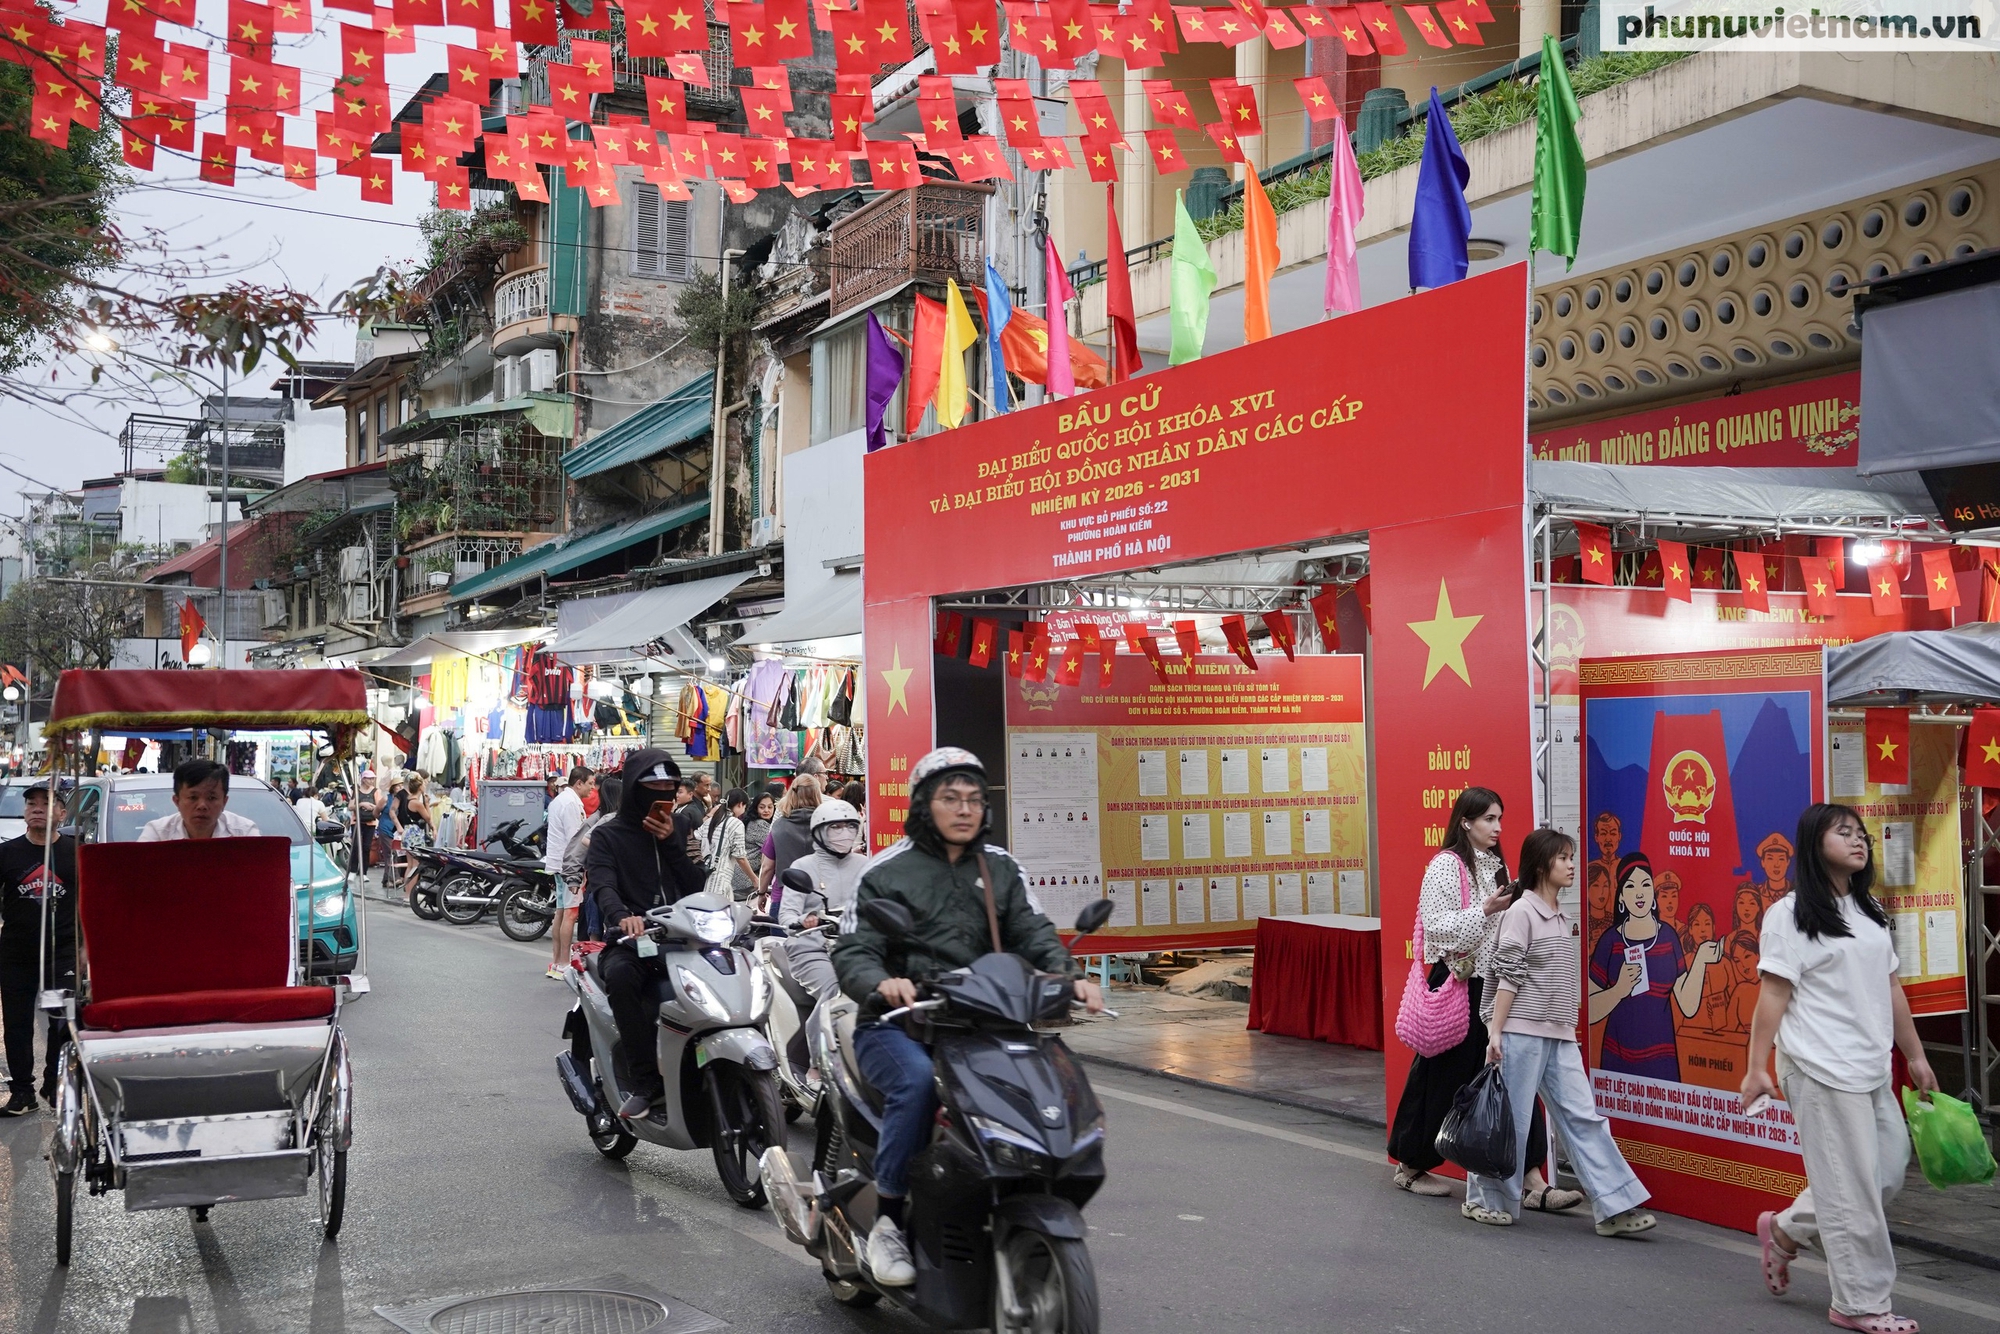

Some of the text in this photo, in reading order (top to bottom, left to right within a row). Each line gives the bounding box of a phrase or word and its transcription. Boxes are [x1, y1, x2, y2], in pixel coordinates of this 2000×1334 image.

[1059, 383, 1162, 434] BẦU CỬ
[978, 390, 1275, 479] ĐẠI BIỂU QUỐC HỘI KHÓA XVI
[1601, 398, 1840, 465] MỪNG ĐẢNG QUANG VINH
[930, 394, 1364, 514] VÀ ĐẠI BIỂU HỘI ĐỒNG NHÂN DÂN CÁC CẤP
[1030, 494, 1076, 516] NHIỆM
[1081, 487, 1101, 507] KỲ
[1104, 480, 1144, 502] 2026
[1160, 468, 1200, 490] 2031
[1060, 518, 1076, 530] KHU
[1078, 514, 1094, 529] VỰC
[1096, 510, 1108, 524] BỎ
[1110, 505, 1136, 522] PHIẾU
[1954, 506, 1976, 522] 46
[1067, 518, 1152, 543] PHƯỜNG HOÀN KIẾM
[1052, 534, 1171, 568] THÀNH PHỐ HÀ NỘI
[1703, 603, 1794, 624] BẢNG NIÊM
[1195, 662, 1230, 675] NIÊM
[1428, 744, 1471, 771] BẦU CỬ
[1422, 785, 1446, 809] GÓP
[1669, 828, 1710, 844] QUỐC HỘI
[1670, 844, 1710, 858] KHOÁ XVI
[1688, 1054, 1733, 1072] HÒM PHIẾU
[1594, 1074, 1612, 1092] NHIỆT
[1613, 1077, 1626, 1096] LIỆT
[1628, 1079, 1645, 1098] CHÀO
[1646, 1082, 1666, 1102] MỪNG
[1668, 1086, 1686, 1106] NGÀY
[1702, 1091, 1712, 1110] CỬ
[1714, 1096, 1726, 1114] ĐẠI
[1727, 1096, 1744, 1116] BIỂU
[1766, 1105, 1779, 1124] HỘI
[1595, 1092, 1604, 1108] VÀ
[1604, 1096, 1616, 1114] ĐẠI
[1617, 1094, 1632, 1112] BIỂU
[1632, 1099, 1644, 1118] HỘI
[1664, 1106, 1684, 1124] NHÂN
[1685, 1108, 1700, 1126] DÂN
[1701, 1110, 1715, 1129] CÁC
[1732, 1117, 1756, 1139] NHIỆM
[1757, 1120, 1768, 1138] KỲ
[1769, 1127, 1787, 1144] 2026
